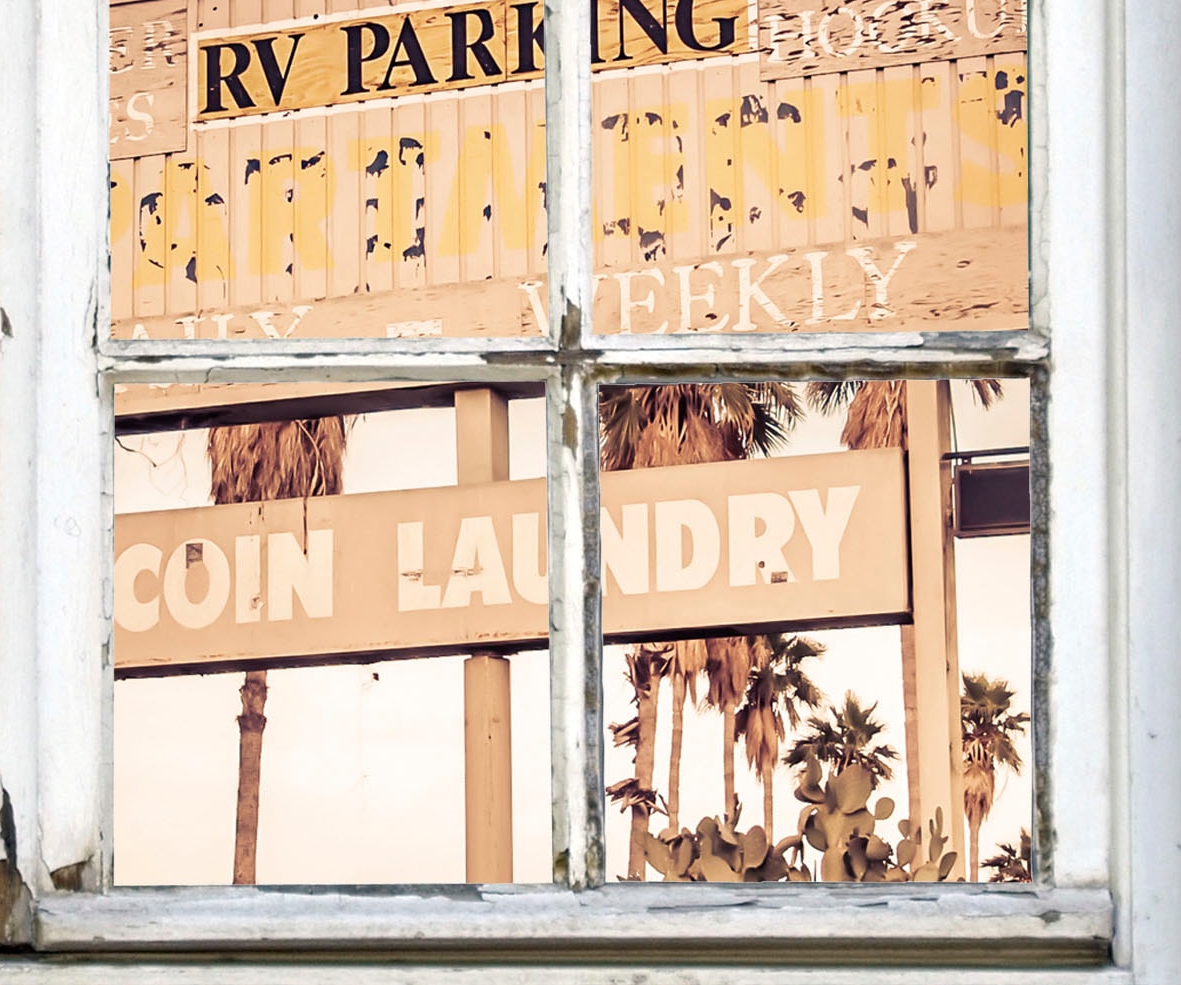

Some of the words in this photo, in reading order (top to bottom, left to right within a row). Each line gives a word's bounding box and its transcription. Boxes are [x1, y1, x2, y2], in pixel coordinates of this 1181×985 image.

[200, 34, 306, 114] RV
[110, 64, 1028, 289] ARTMENTS
[114, 527, 334, 632] COIN
[397, 485, 862, 612] LAUNDRY
